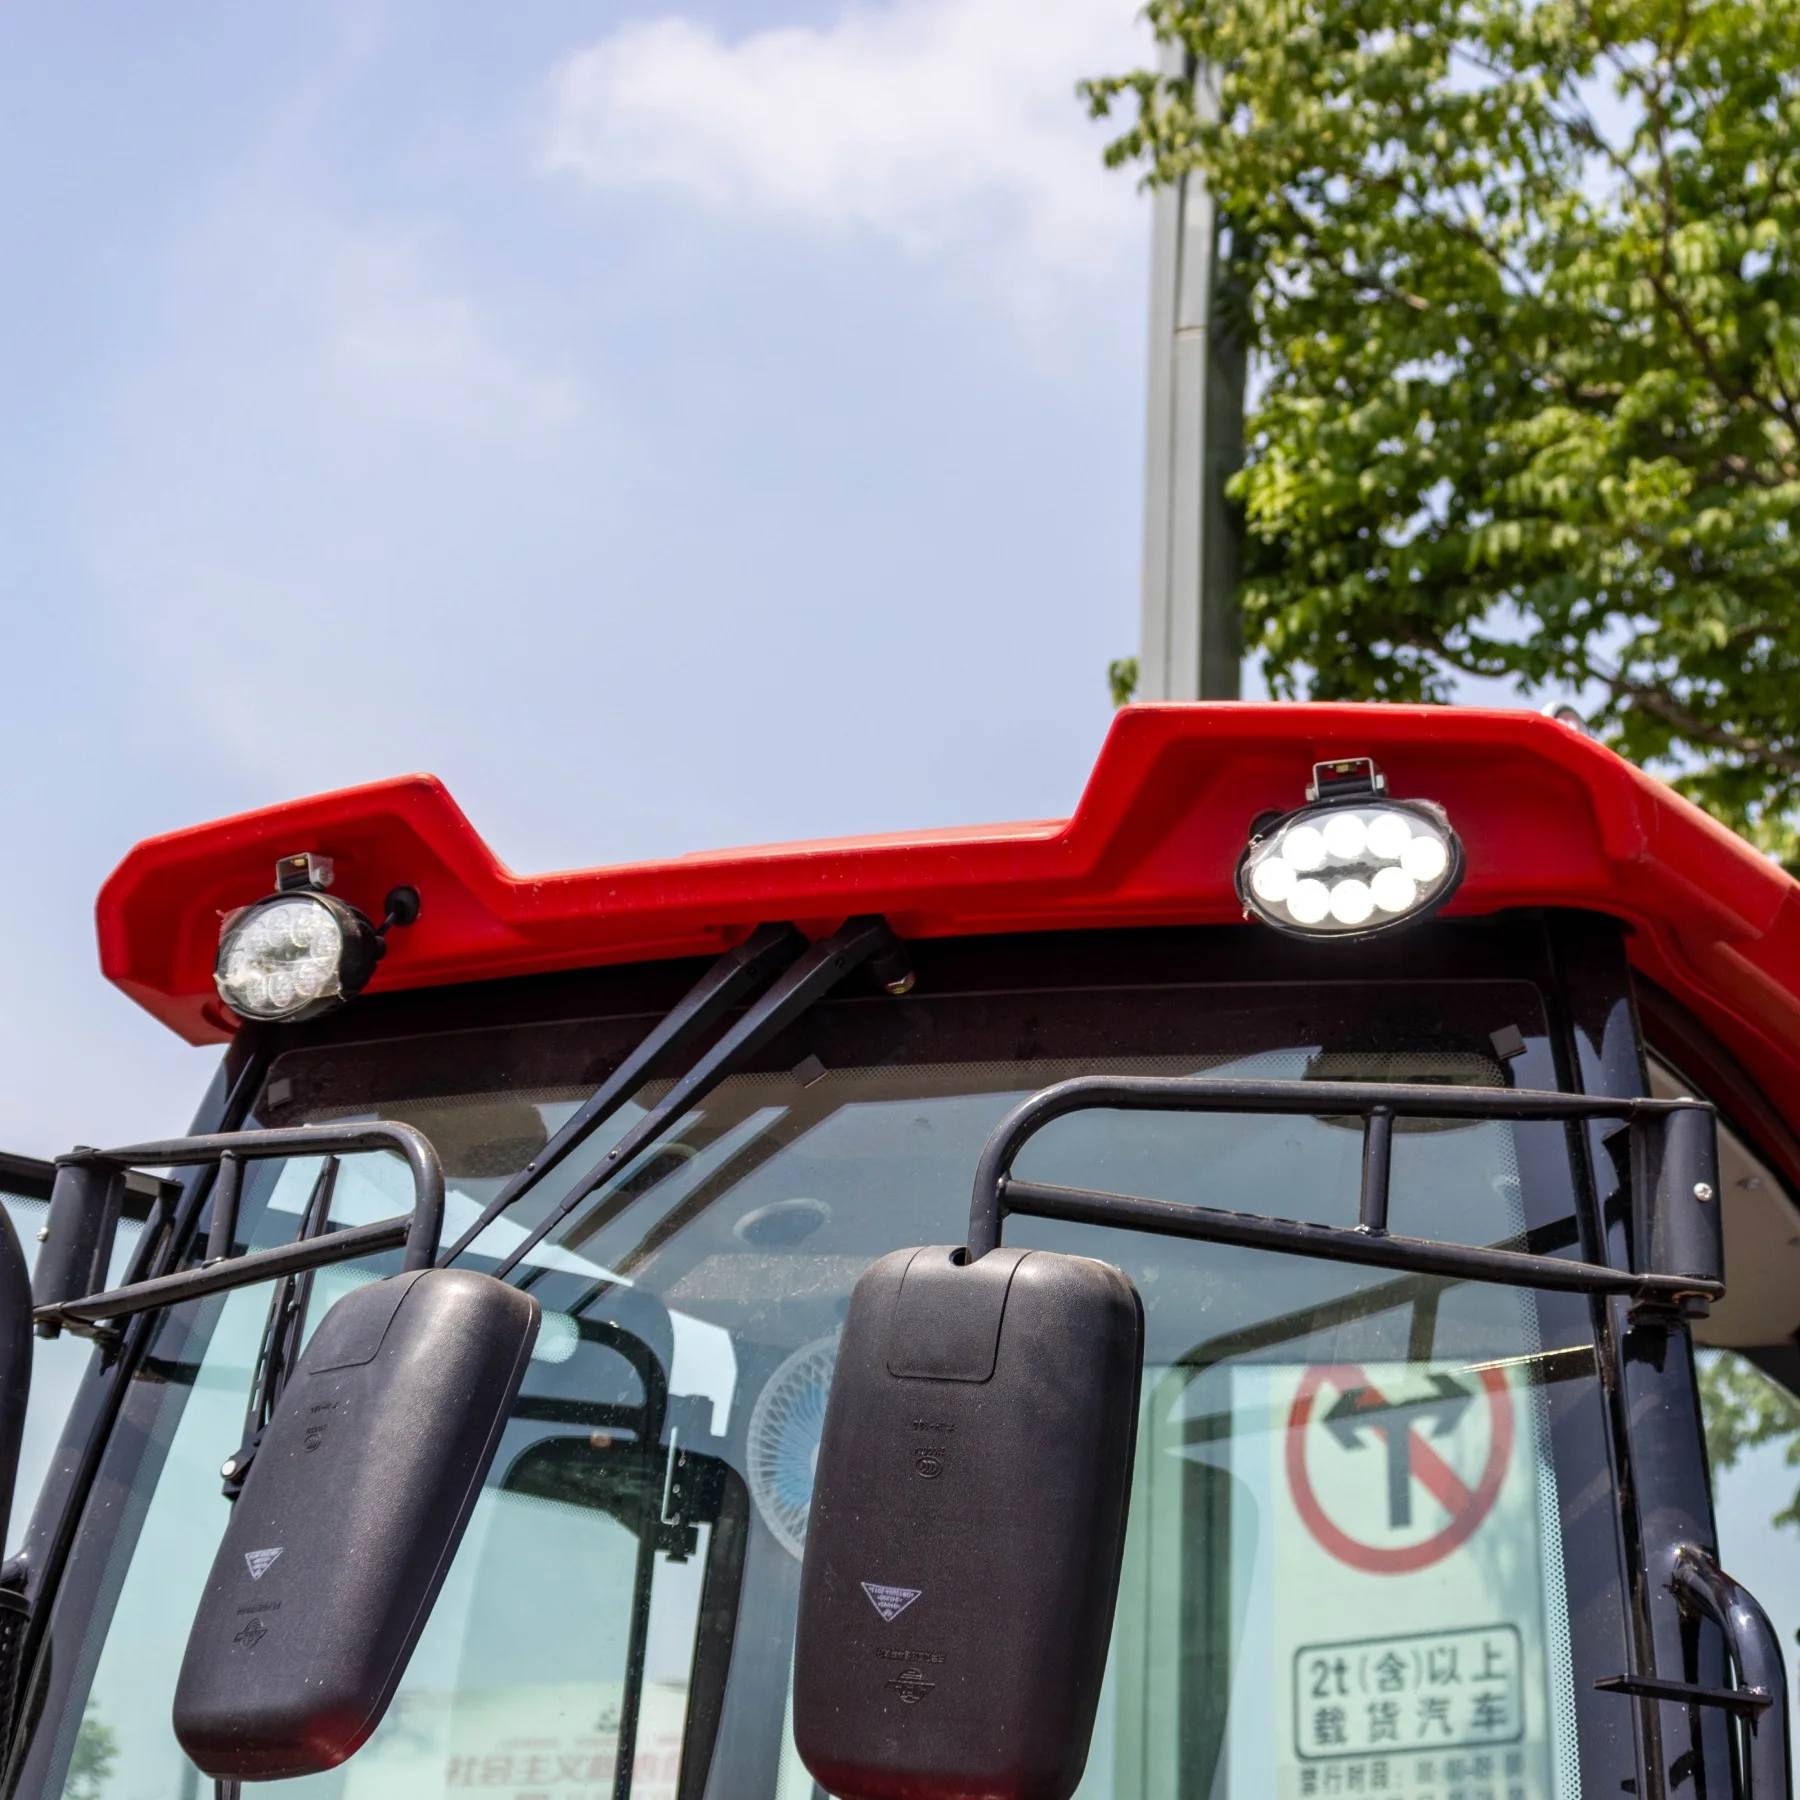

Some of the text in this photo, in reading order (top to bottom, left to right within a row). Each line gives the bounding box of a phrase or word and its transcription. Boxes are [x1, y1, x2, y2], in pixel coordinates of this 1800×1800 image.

[1311, 1641, 1508, 1698] 2t(含)以上
[1312, 1692, 1507, 1745] 载货汽车
